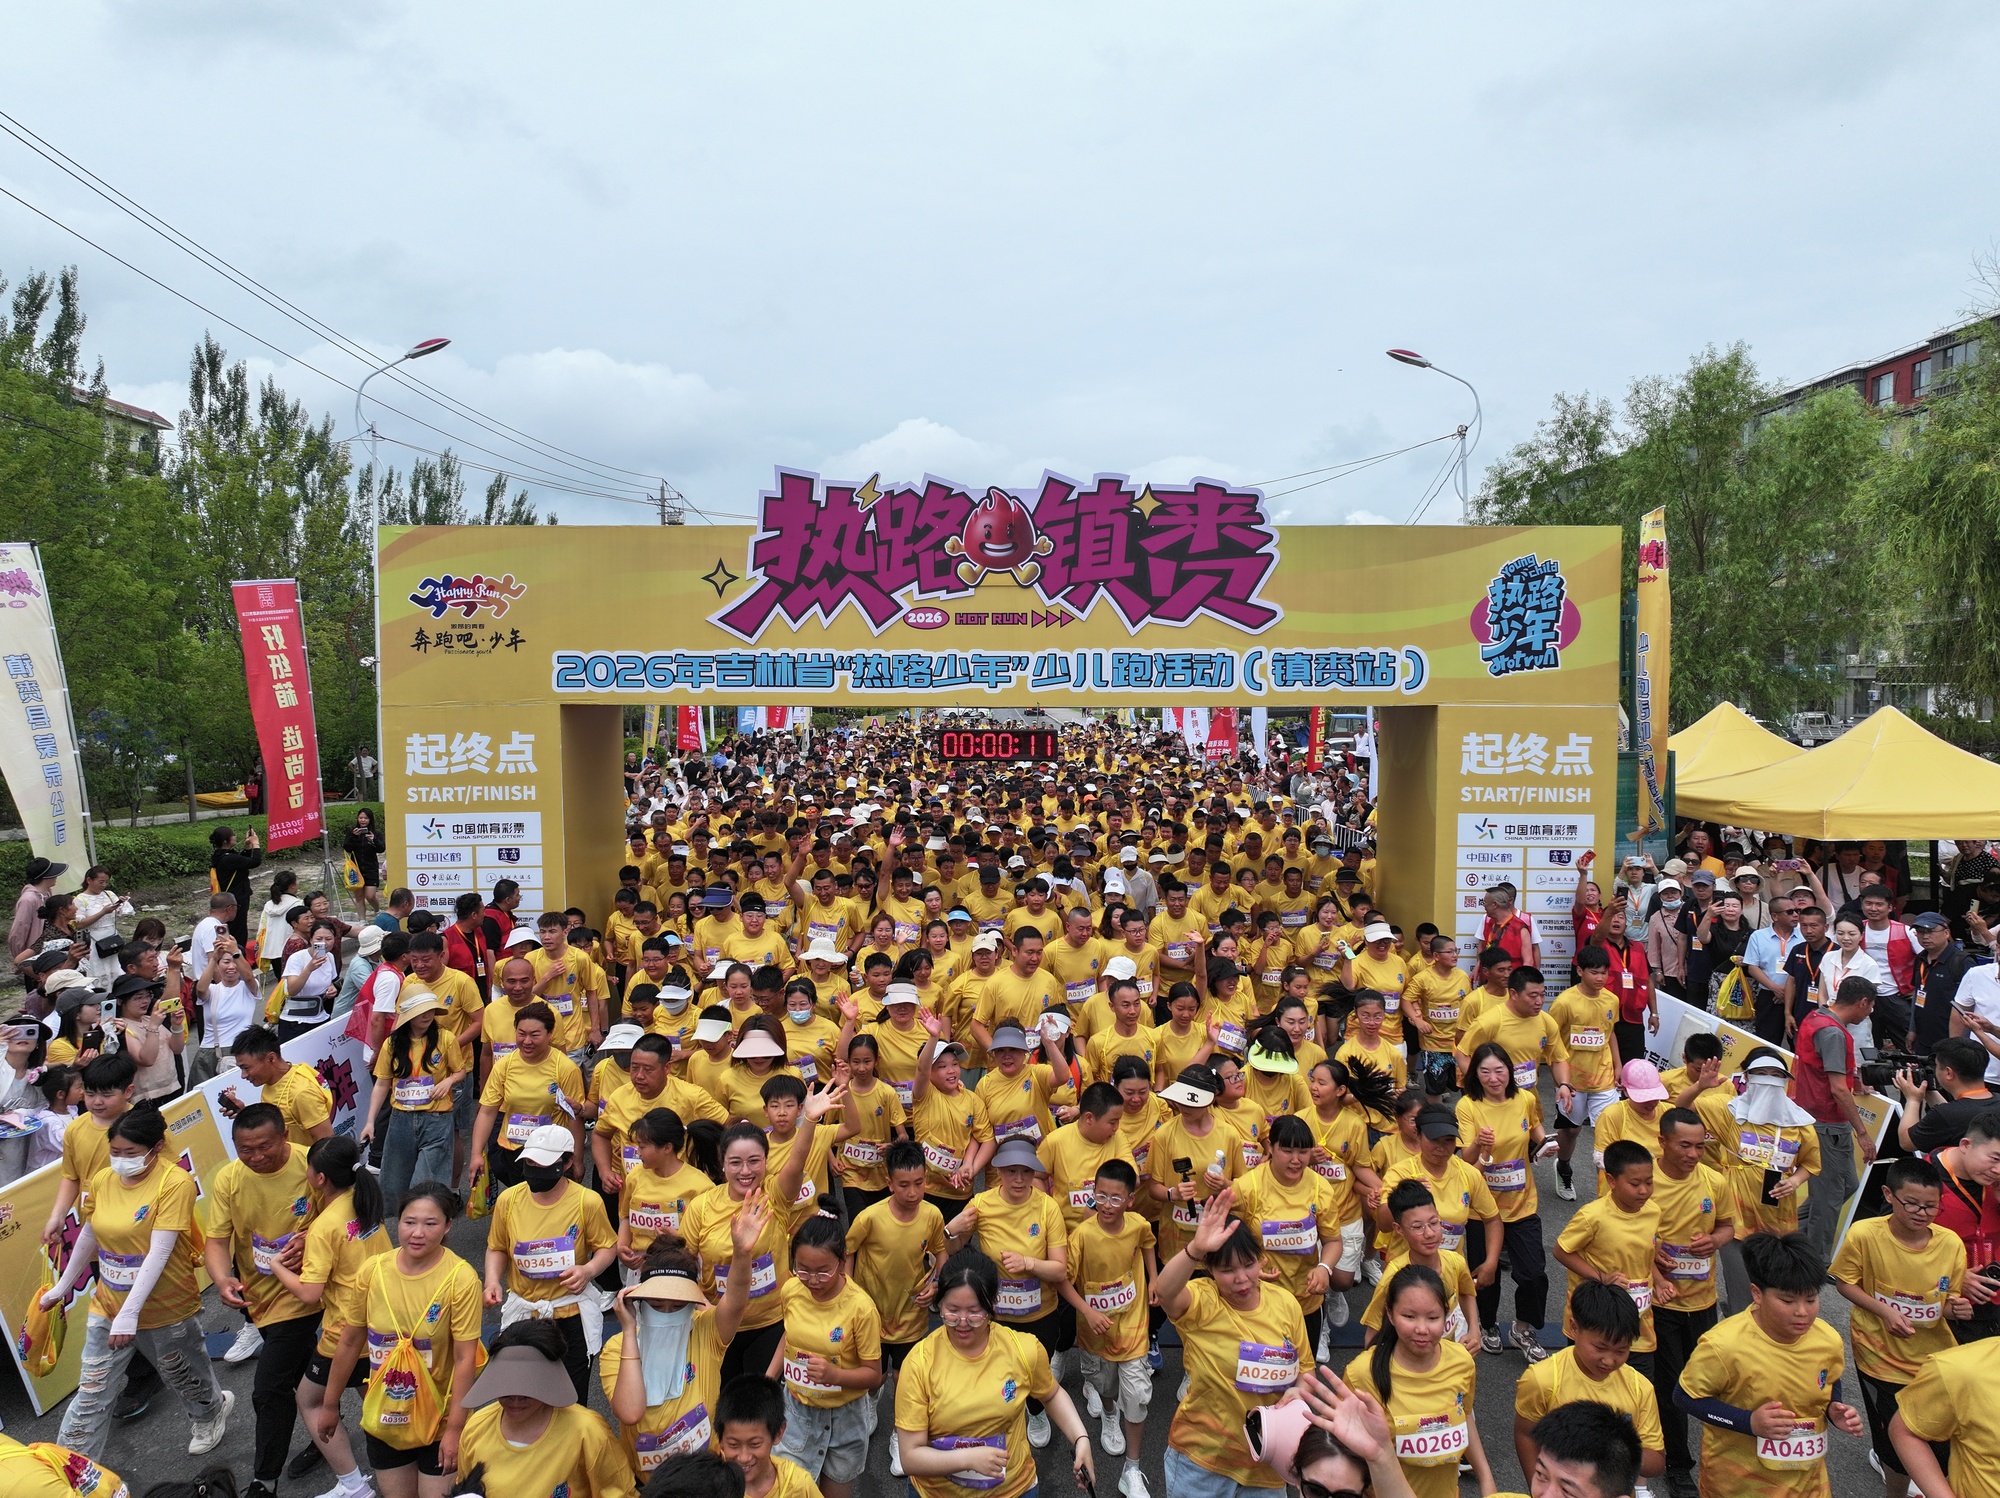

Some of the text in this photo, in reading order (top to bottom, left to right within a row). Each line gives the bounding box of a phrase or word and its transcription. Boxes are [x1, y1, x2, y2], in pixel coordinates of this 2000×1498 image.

[1501, 555, 1559, 578] Young child
[434, 583, 501, 601] Happy Run
[907, 611, 943, 625] 2026
[955, 612, 1028, 626] HOT RUN
[871, 718, 880, 729] A
[405, 731, 538, 776] 起终点
[943, 732, 1052, 758] 00:00:11
[1460, 733, 1593, 776] 起终点
[407, 785, 536, 804] START/FINISH
[1460, 786, 1591, 807] START/FINISH
[452, 823, 525, 835] 中国体育彩票
[1504, 825, 1578, 836] 中国体育彩票
[416, 852, 462, 862] 中国飞鹤
[1466, 852, 1512, 863] 中国飞鹤
[1571, 1033, 1604, 1045] A0375
[922, 1145, 956, 1170] A0133
[1742, 1145, 1790, 1166] A025-1
[630, 1215, 671, 1228] A0085
[1265, 1232, 1314, 1248] A0400-1
[517, 1255, 565, 1269] A0345-1
[1089, 1289, 1133, 1310] A0106
[1239, 1364, 1298, 1382] A0269-1
[1399, 1430, 1462, 1454] A0269
[1761, 1437, 1823, 1458] A0433
